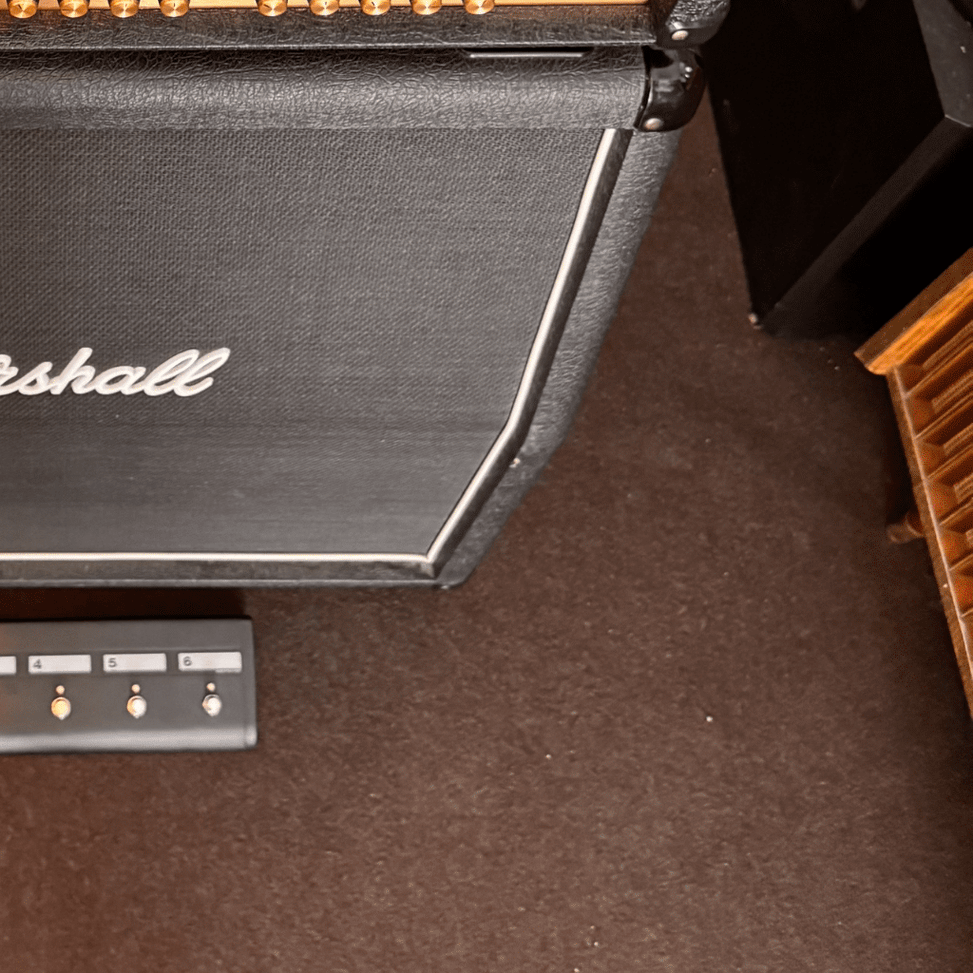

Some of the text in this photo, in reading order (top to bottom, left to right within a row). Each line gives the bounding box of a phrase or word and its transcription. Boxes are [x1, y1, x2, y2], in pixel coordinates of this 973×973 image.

[33, 660, 42, 670] 4
[108, 658, 117, 668] 5
[183, 656, 192, 667] 6
